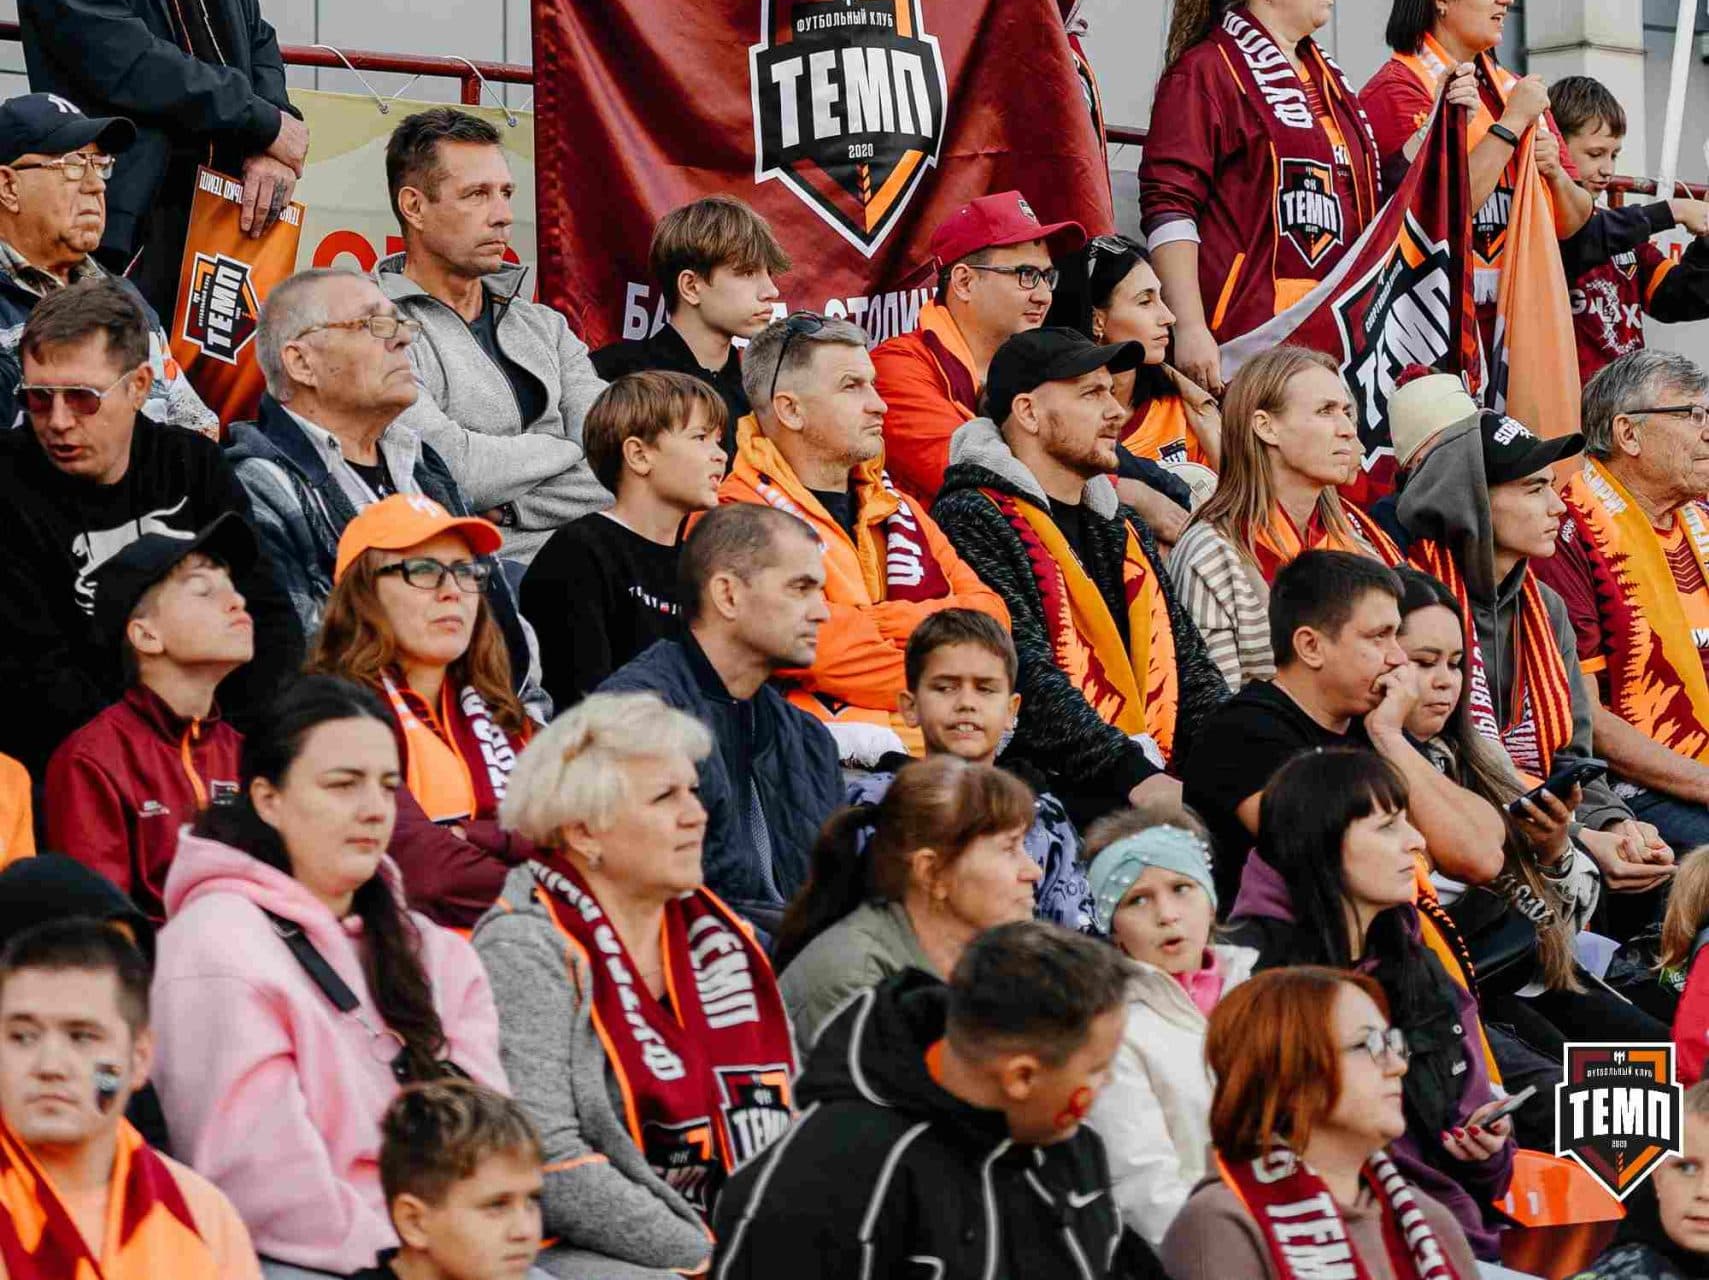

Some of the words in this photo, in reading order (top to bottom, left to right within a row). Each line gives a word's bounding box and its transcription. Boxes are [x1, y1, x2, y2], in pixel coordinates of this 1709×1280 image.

[796, 8, 867, 32] ФУТБОЛЬНЫЙ
[870, 11, 893, 28] КЛУБ
[771, 47, 933, 149] ТЕМП
[848, 143, 874, 159] 2020
[1282, 190, 1337, 233] ТЕМП
[206, 264, 244, 349] ТЕМП
[1266, 1190, 1358, 1280] ТЕМ
